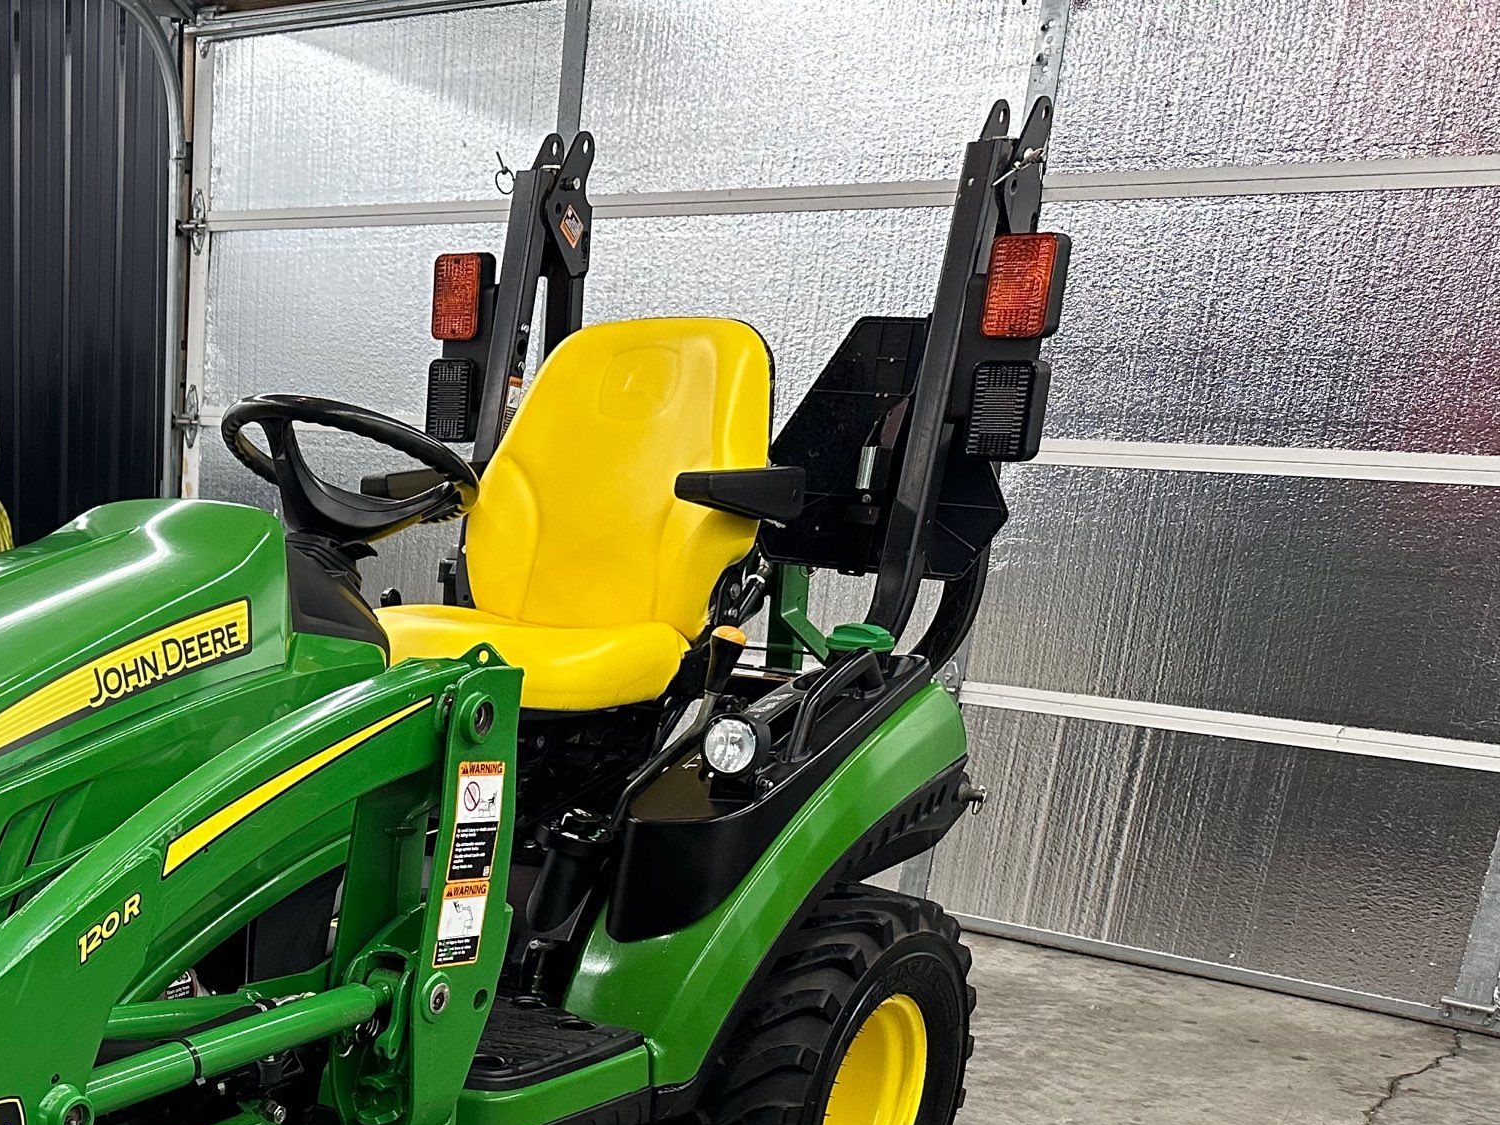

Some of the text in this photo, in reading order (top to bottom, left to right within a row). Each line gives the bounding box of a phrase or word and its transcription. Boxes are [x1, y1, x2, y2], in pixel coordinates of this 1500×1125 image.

[89, 621, 242, 704] JOHN DEERE
[470, 763, 503, 774] WARNING
[452, 884, 487, 896] WARNING
[78, 892, 141, 965] 120 R
